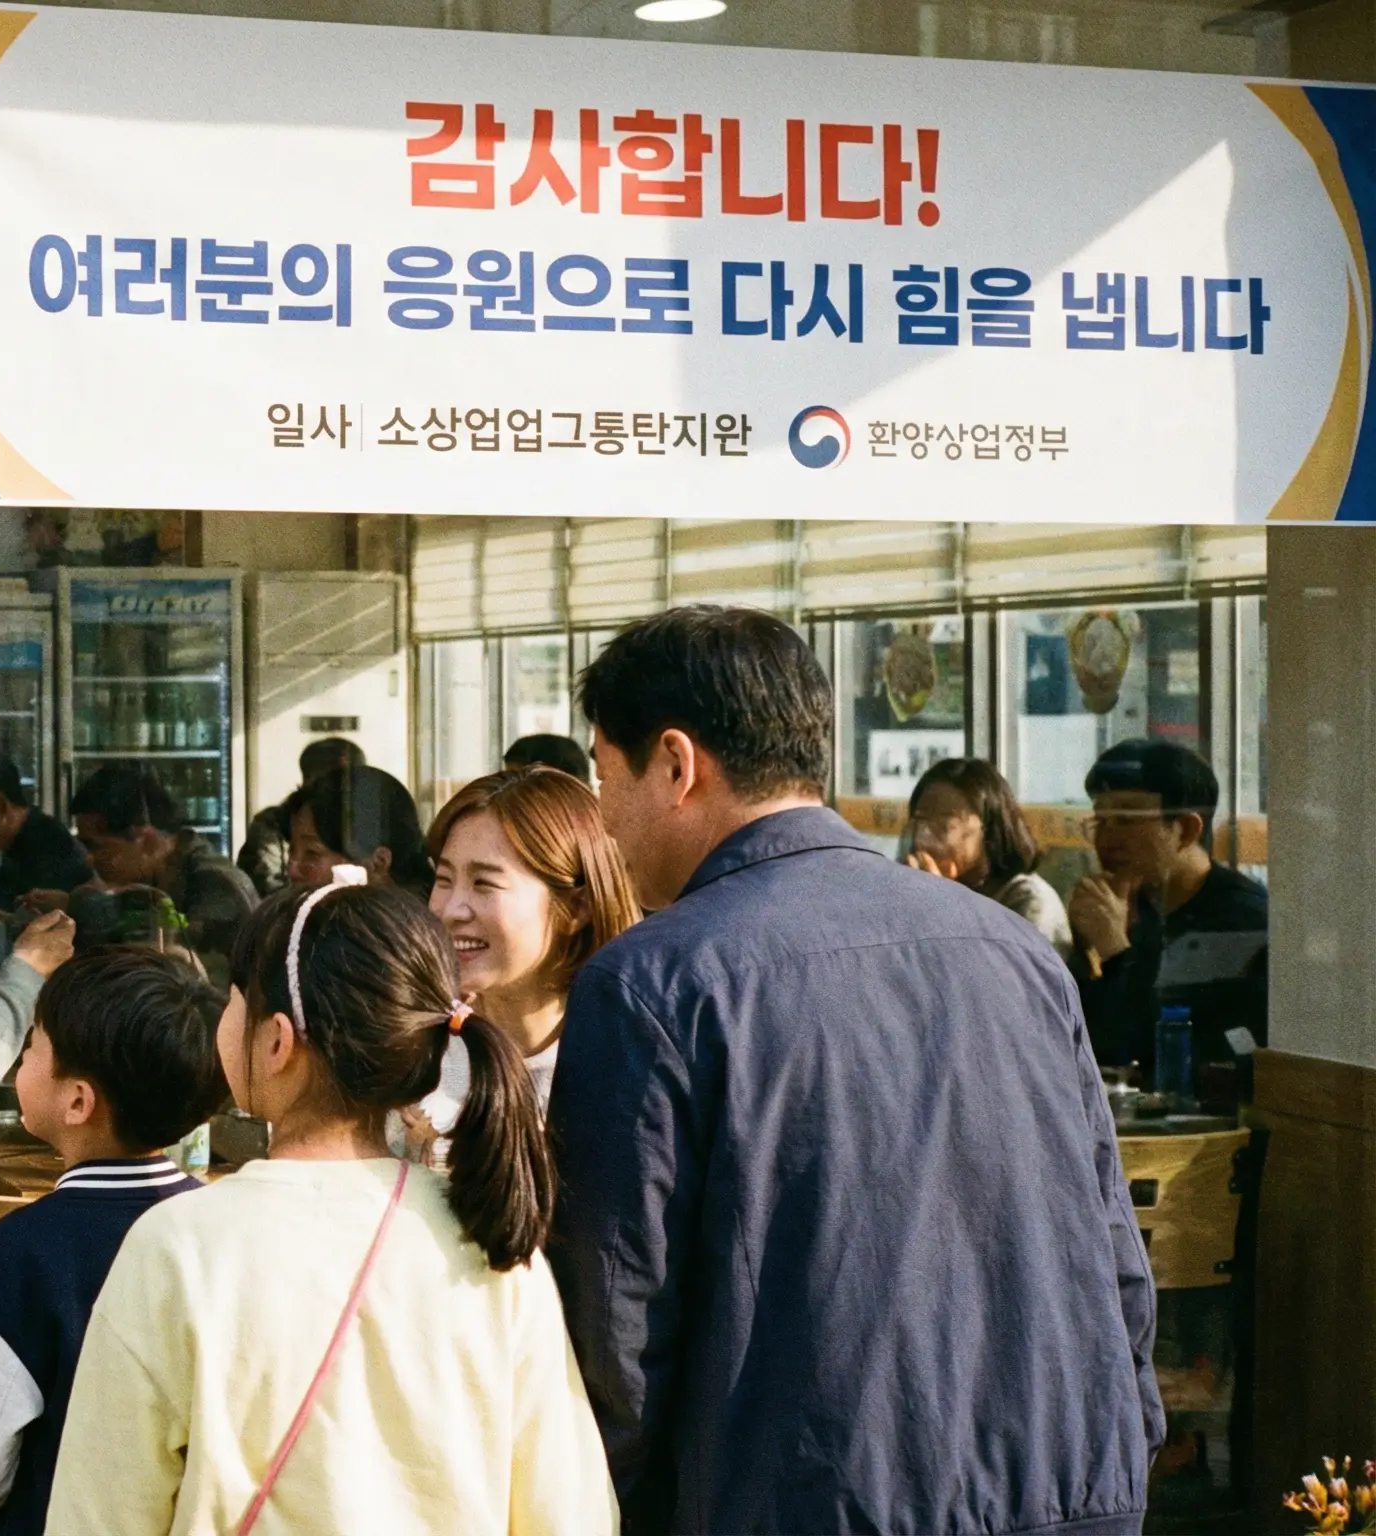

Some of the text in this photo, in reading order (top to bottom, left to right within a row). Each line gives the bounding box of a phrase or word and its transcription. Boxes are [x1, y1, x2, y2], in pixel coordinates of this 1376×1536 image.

[405, 102, 940, 228] 감사합니다!
[28, 233, 1272, 356] 여러분의 응원으로 다시 힘을 냅니다
[267, 402, 353, 450] 일사
[867, 420, 1070, 462] 환양상업정부
